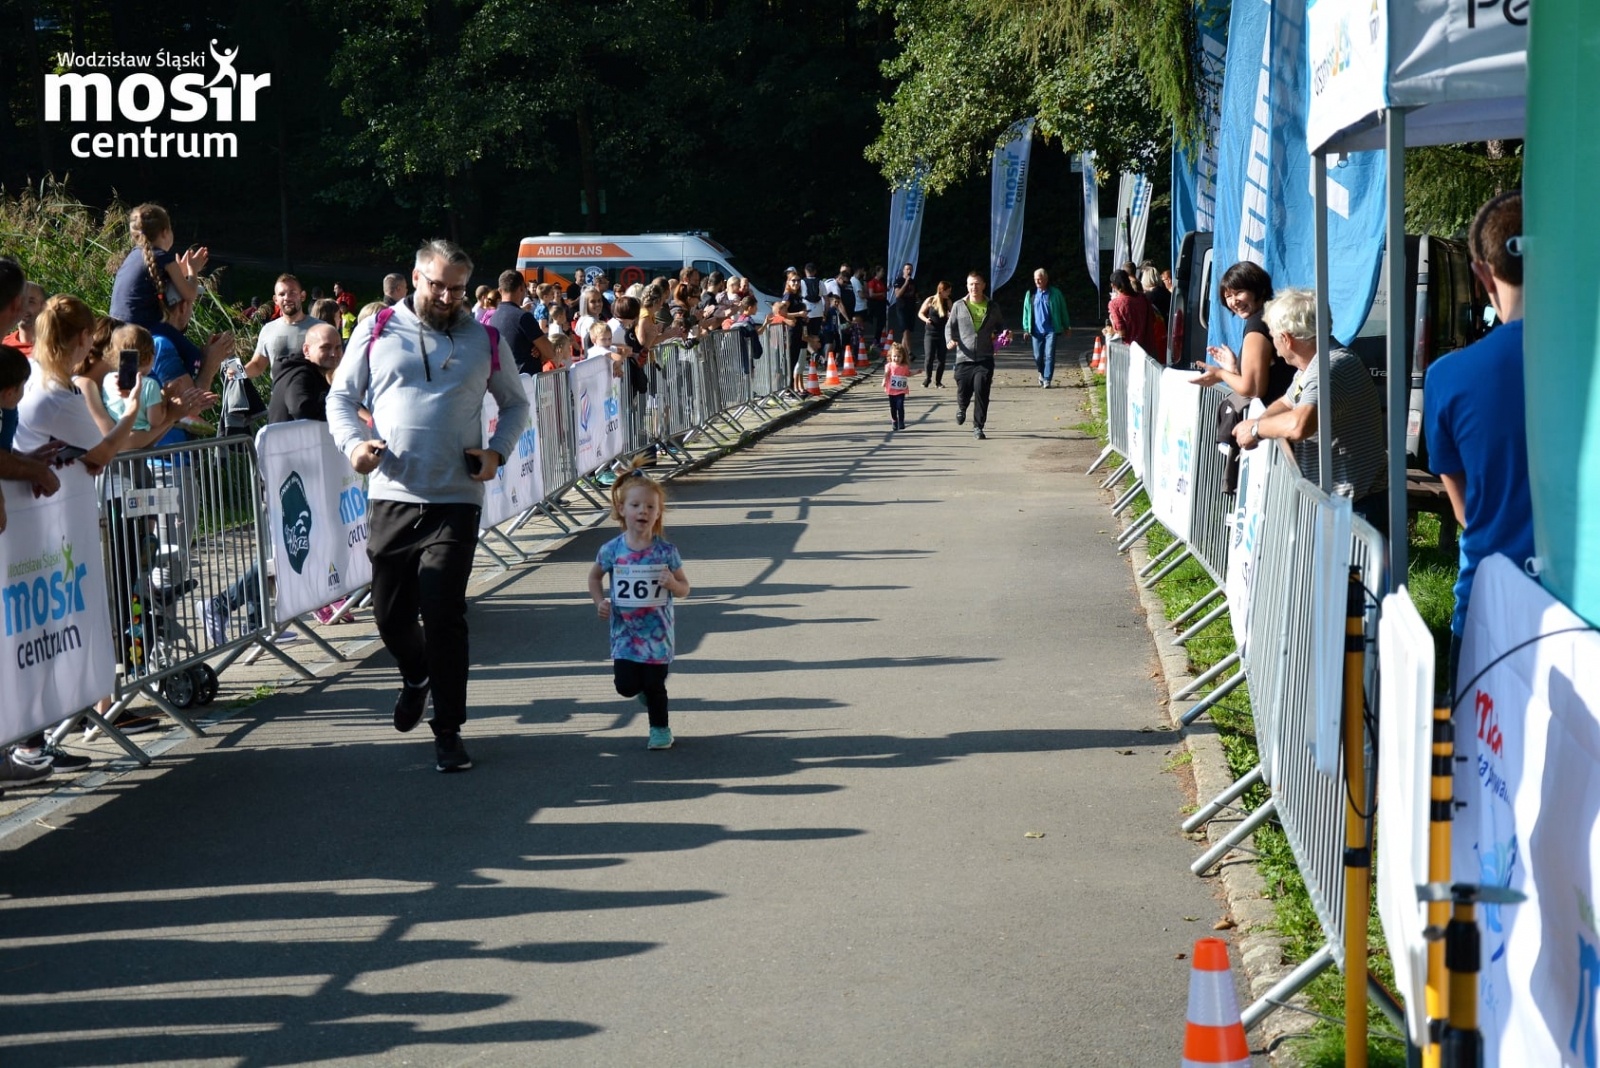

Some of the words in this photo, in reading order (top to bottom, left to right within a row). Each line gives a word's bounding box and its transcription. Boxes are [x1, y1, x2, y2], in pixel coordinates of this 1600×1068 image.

[537, 245, 603, 256] AMBULANS
[617, 579, 662, 599] 267
[2, 562, 87, 637] mosir
